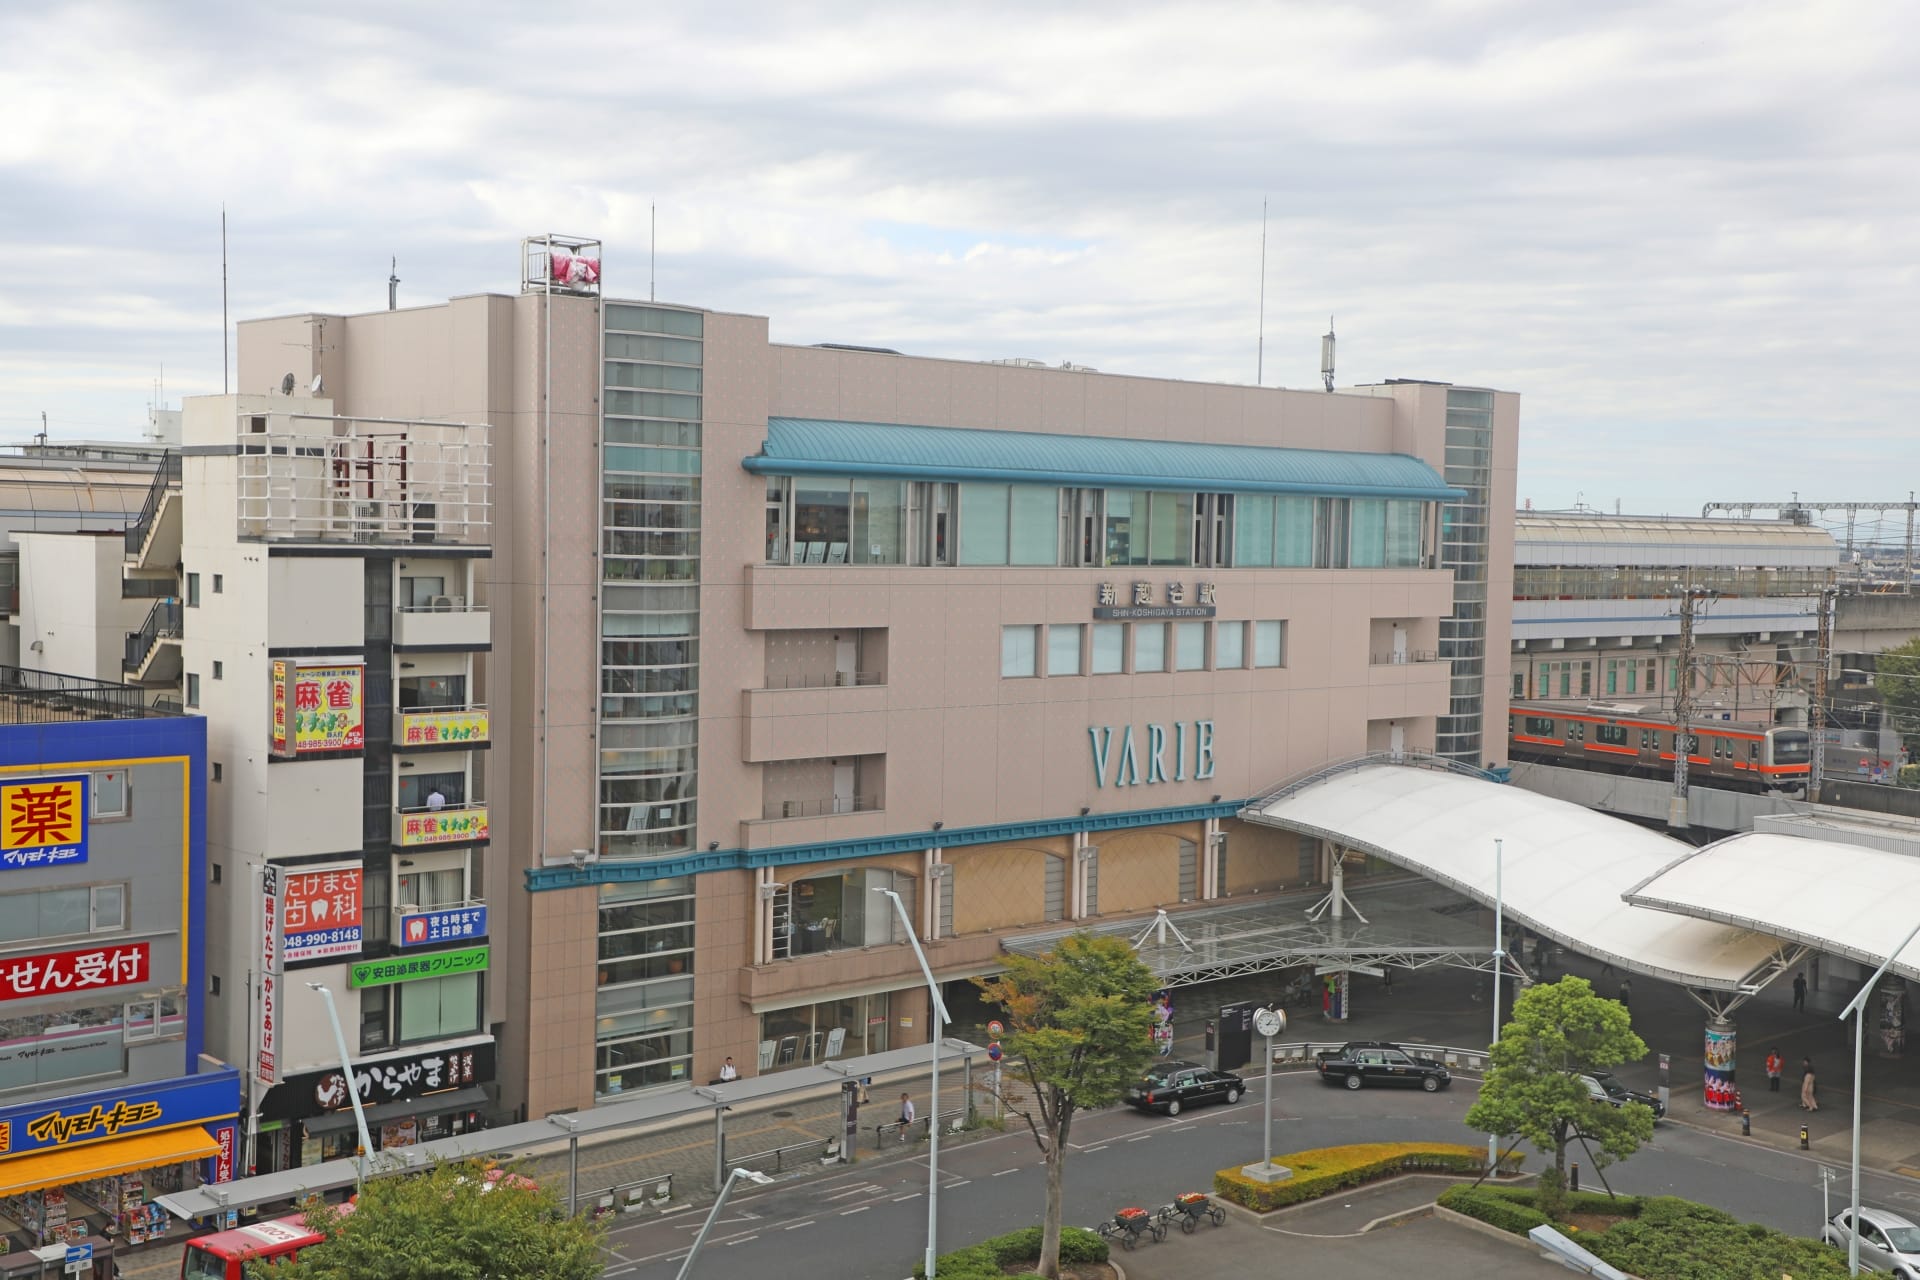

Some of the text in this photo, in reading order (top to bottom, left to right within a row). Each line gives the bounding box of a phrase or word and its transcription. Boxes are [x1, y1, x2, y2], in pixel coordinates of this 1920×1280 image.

[1097, 582, 1217, 605] 新越谷駅
[1112, 607, 1207, 618] SHIN-KOSHIGAYA STATION
[275, 684, 285, 725] 麻雀
[296, 681, 351, 709] 麻雀
[407, 726, 438, 741] 麻雀
[1088, 720, 1216, 788] VARIE
[11, 785, 72, 845] 薬
[406, 818, 437, 834] 麻雀
[4, 846, 79, 865] マツモトキヨシ
[284, 871, 359, 897] たけまさ
[430, 912, 480, 928] 夜8時まで
[430, 924, 473, 939] 土日診療
[0, 948, 142, 994] せん受付
[373, 952, 486, 979] 安田泌尿器クリニック
[263, 976, 274, 1049] からあげ
[354, 1056, 445, 1097] からやま
[28, 1101, 163, 1143] マツモトキヨシ
